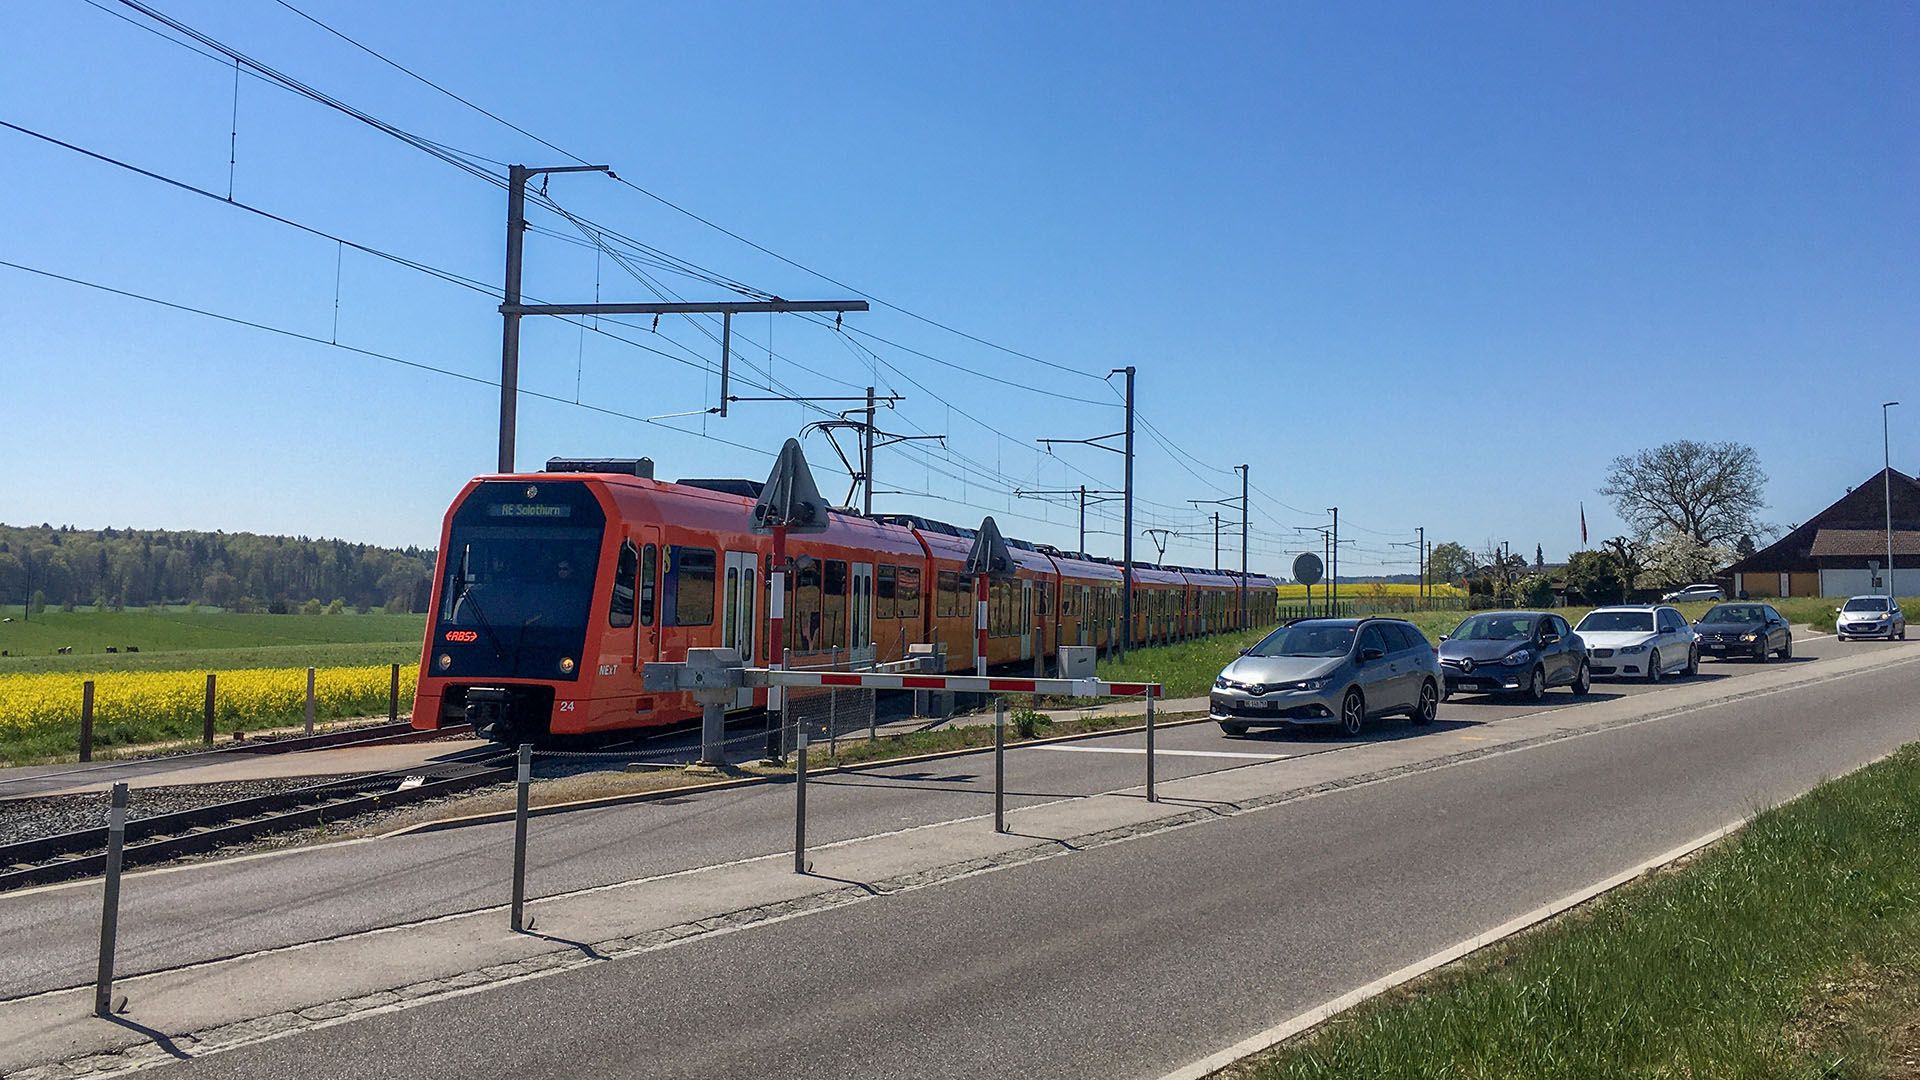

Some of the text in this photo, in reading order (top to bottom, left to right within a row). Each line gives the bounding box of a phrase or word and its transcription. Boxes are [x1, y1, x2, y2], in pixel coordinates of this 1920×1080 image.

[502, 503, 560, 516] RE Solothurn
[450, 631, 473, 642] RBS
[560, 701, 575, 712] 24
